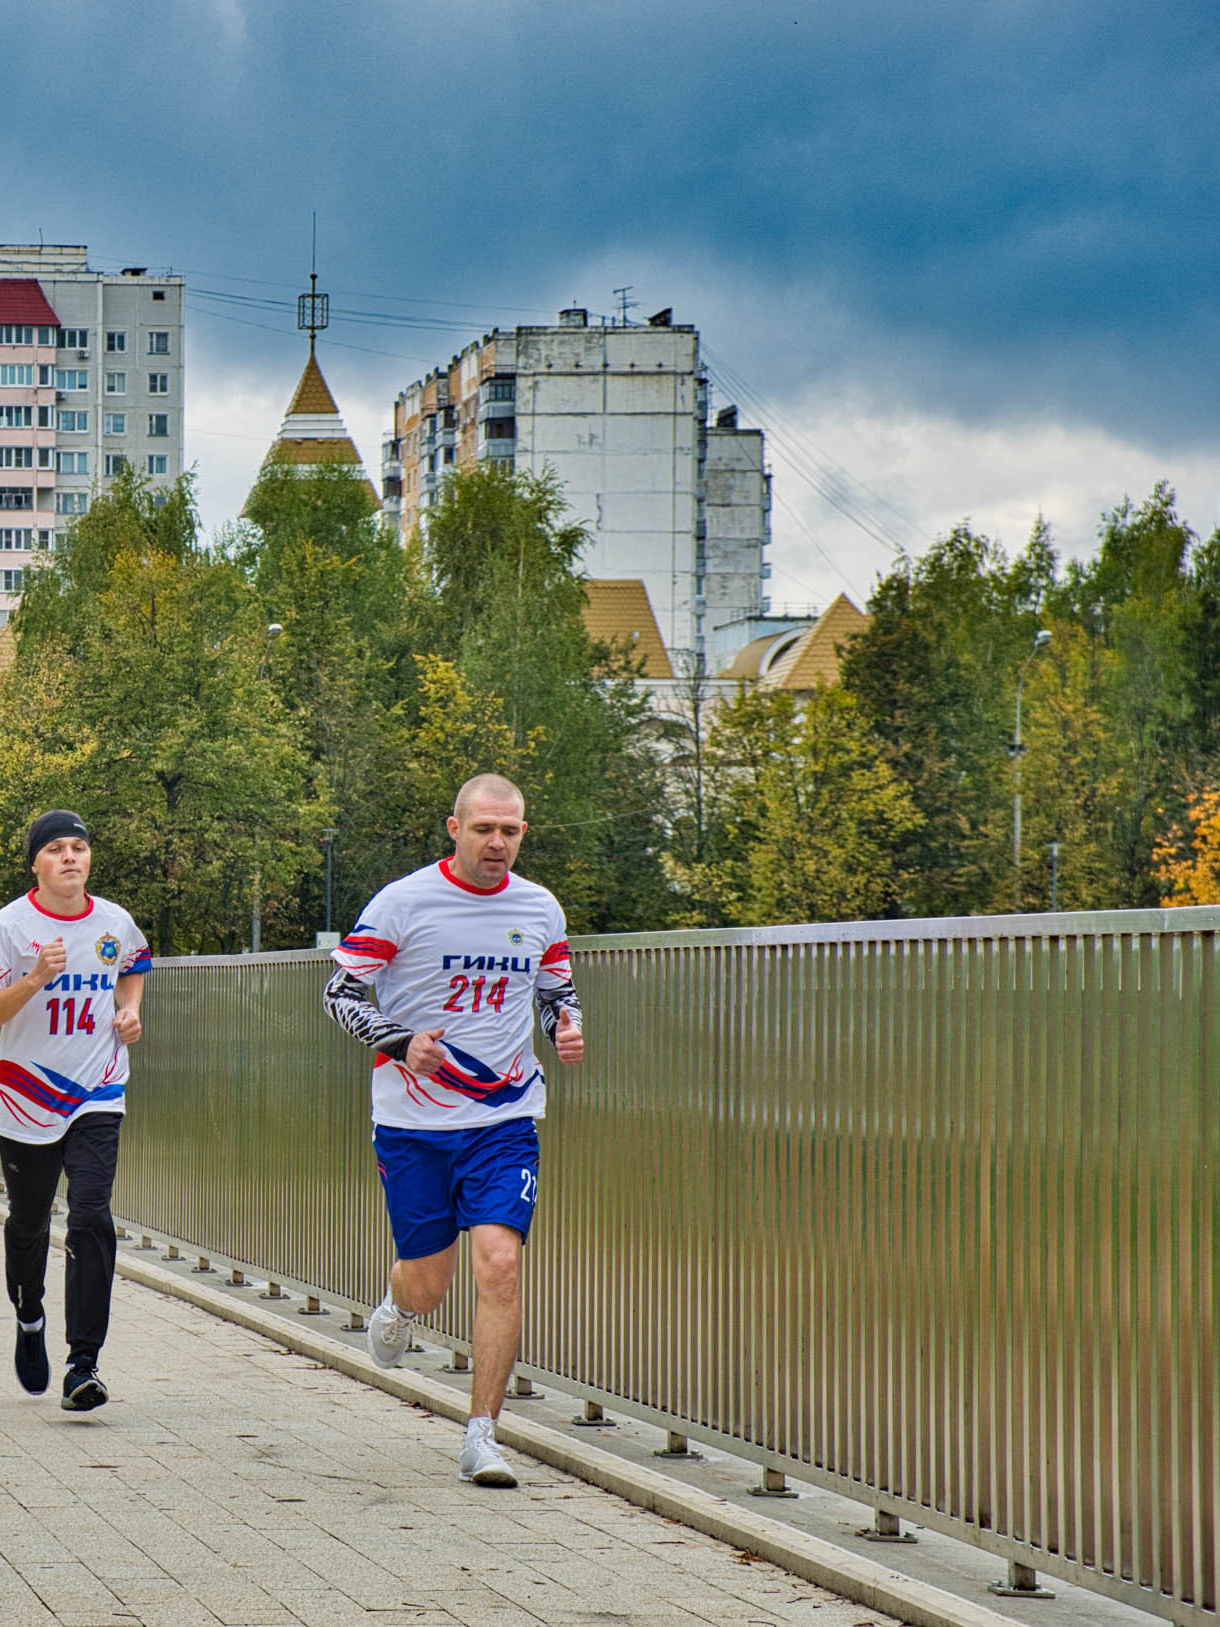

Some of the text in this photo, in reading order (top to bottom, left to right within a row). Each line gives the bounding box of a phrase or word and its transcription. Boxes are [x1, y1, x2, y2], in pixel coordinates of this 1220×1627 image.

[22, 970, 114, 992] ИКЦ
[443, 975, 509, 1013] 214
[45, 997, 96, 1035] 114
[520, 1168, 538, 1205] 21
